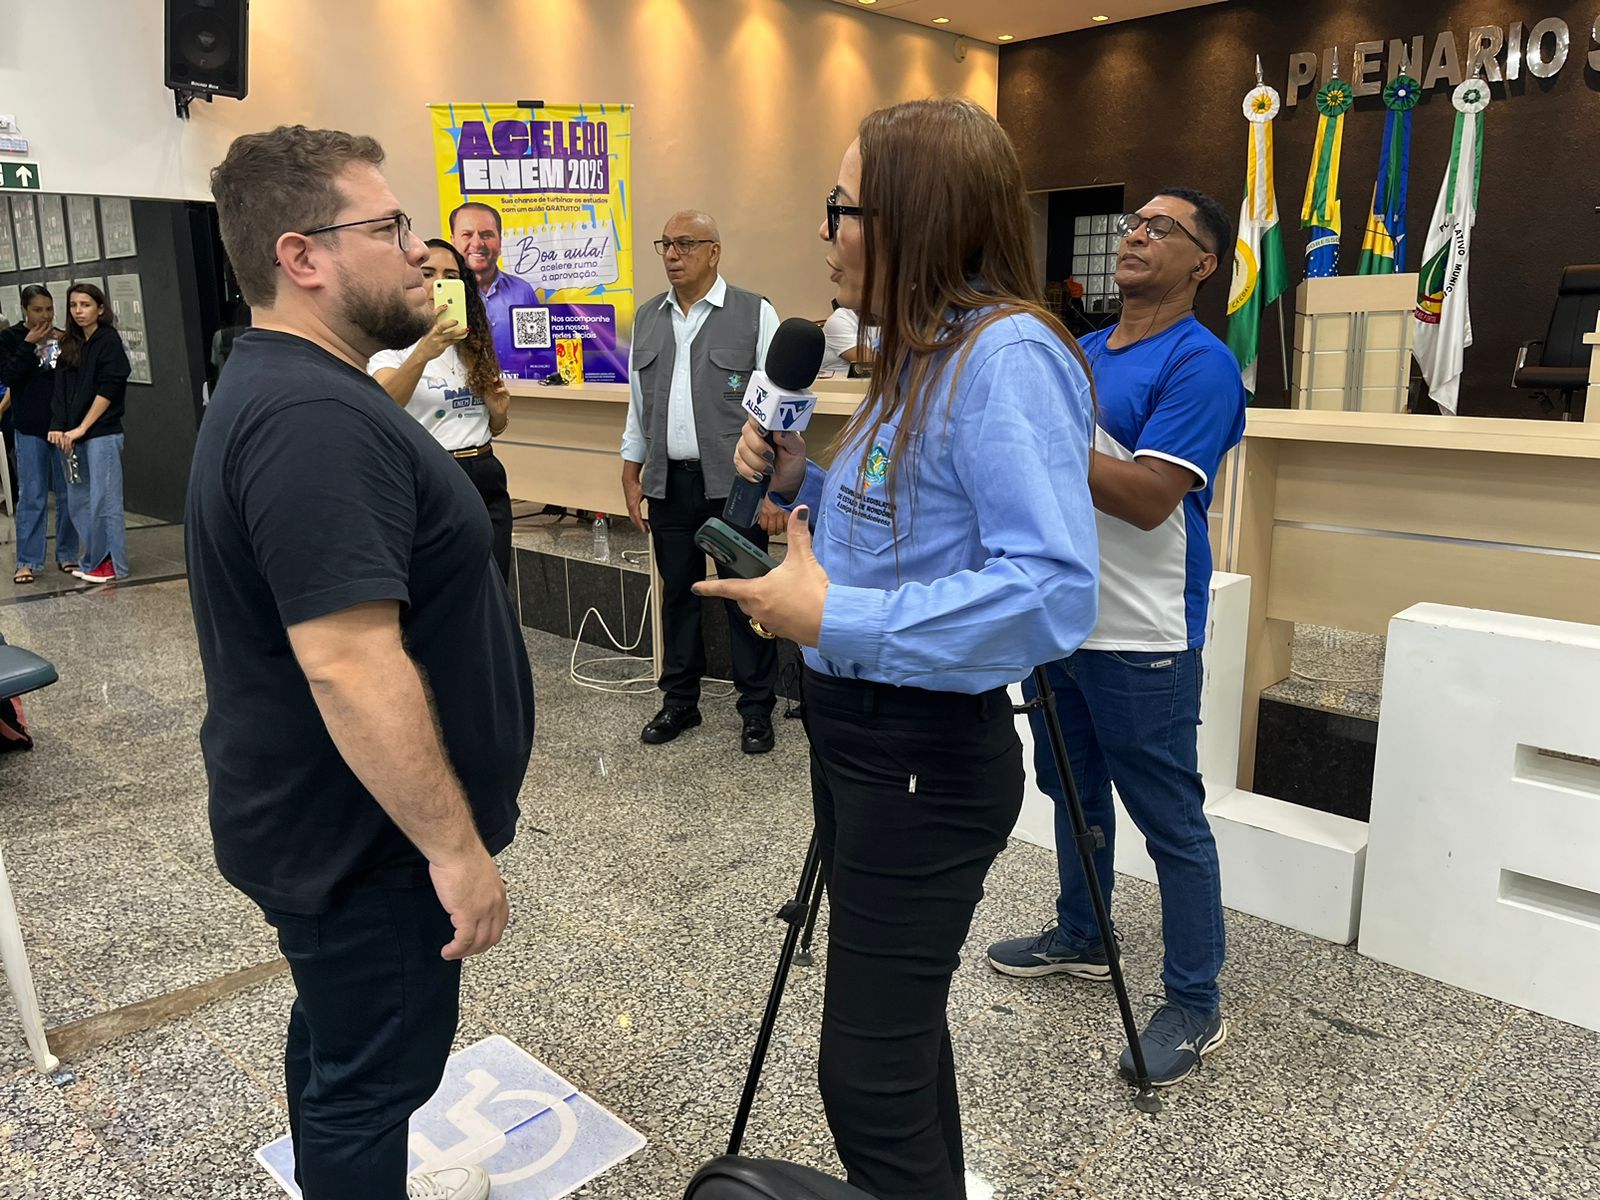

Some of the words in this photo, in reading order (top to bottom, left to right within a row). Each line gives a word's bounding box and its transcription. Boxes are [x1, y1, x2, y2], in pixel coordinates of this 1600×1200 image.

[1285, 17, 1570, 106] PLENARIO
[458, 120, 608, 155] ACELERO
[463, 159, 564, 190] ENEM
[568, 159, 604, 189] 2025
[514, 235, 558, 275] Boa
[564, 236, 609, 259] aula!
[540, 261, 572, 272] acelere
[574, 260, 598, 270] rumo
[549, 270, 599, 282] aprovação.
[564, 315, 610, 323] acompanhe
[746, 399, 767, 422] ALERO
